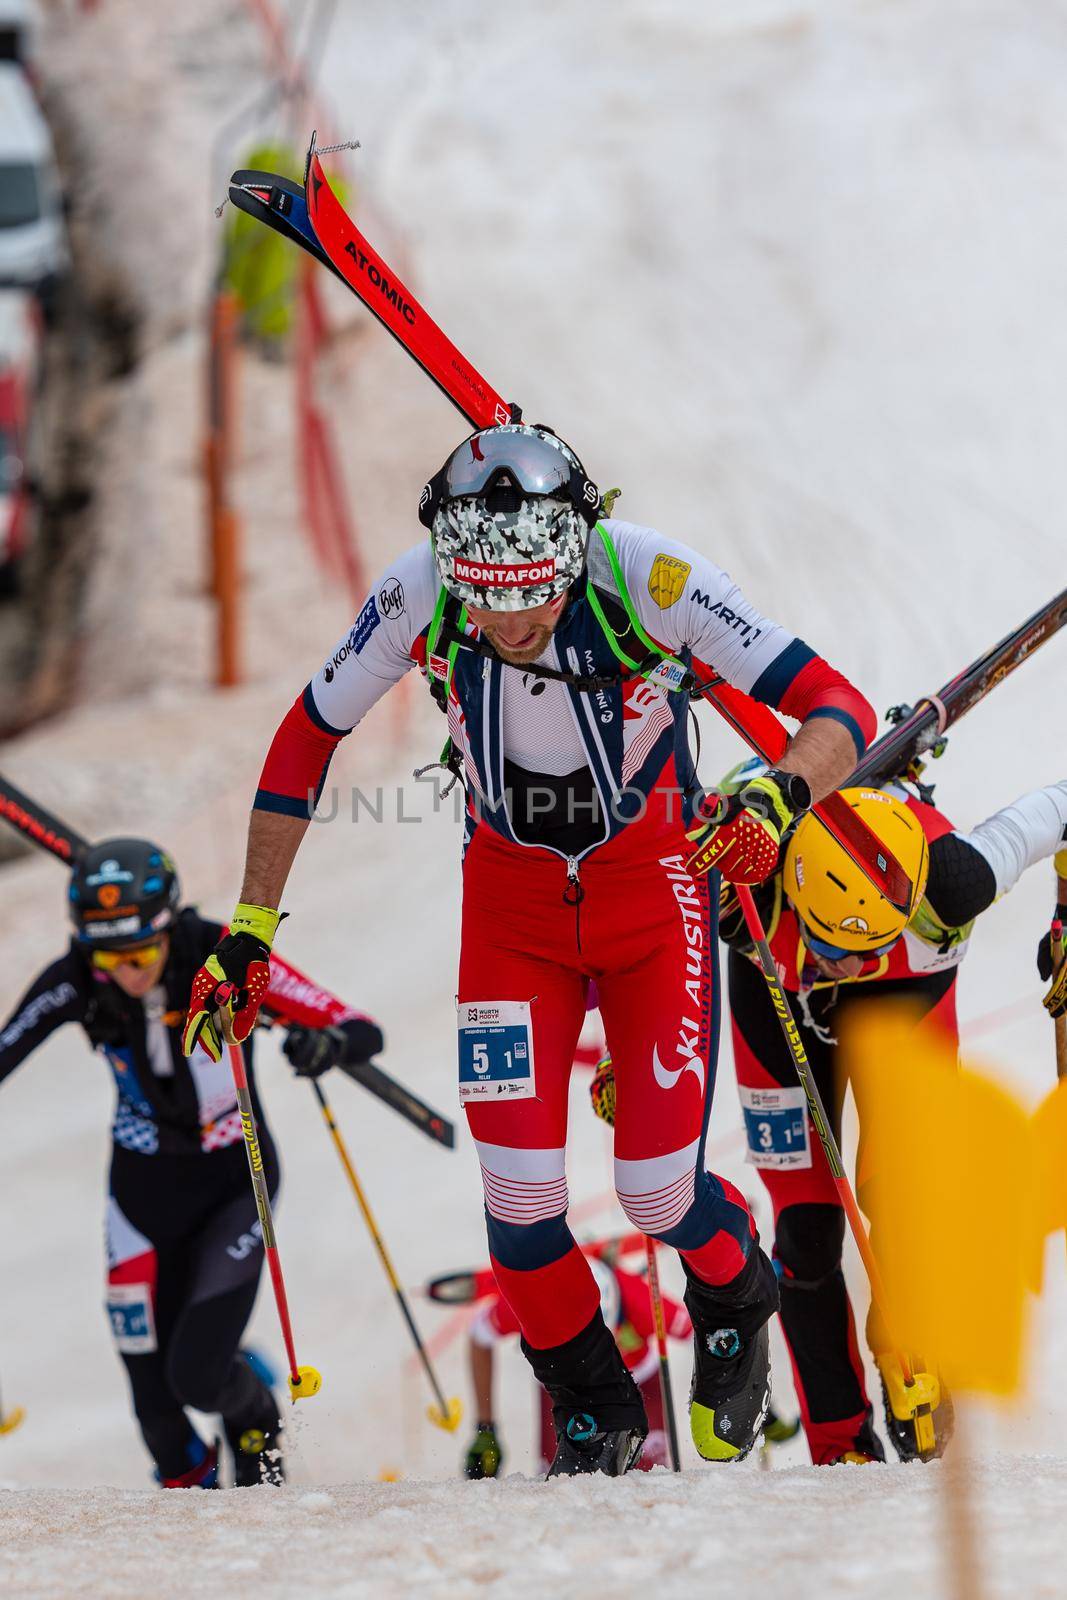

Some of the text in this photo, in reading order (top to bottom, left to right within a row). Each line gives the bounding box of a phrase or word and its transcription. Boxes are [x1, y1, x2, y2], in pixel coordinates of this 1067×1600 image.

[343, 241, 417, 326] ATOMIC
[456, 563, 554, 583] MONTAFON
[656, 556, 689, 573] PIEPS
[695, 838, 724, 869] LEKI
[658, 854, 703, 1008] AUSTRIA
[472, 1043, 490, 1074] 5
[503, 1050, 513, 1069] 1
[758, 1122, 773, 1148] 3
[784, 1128, 792, 1144] 1
